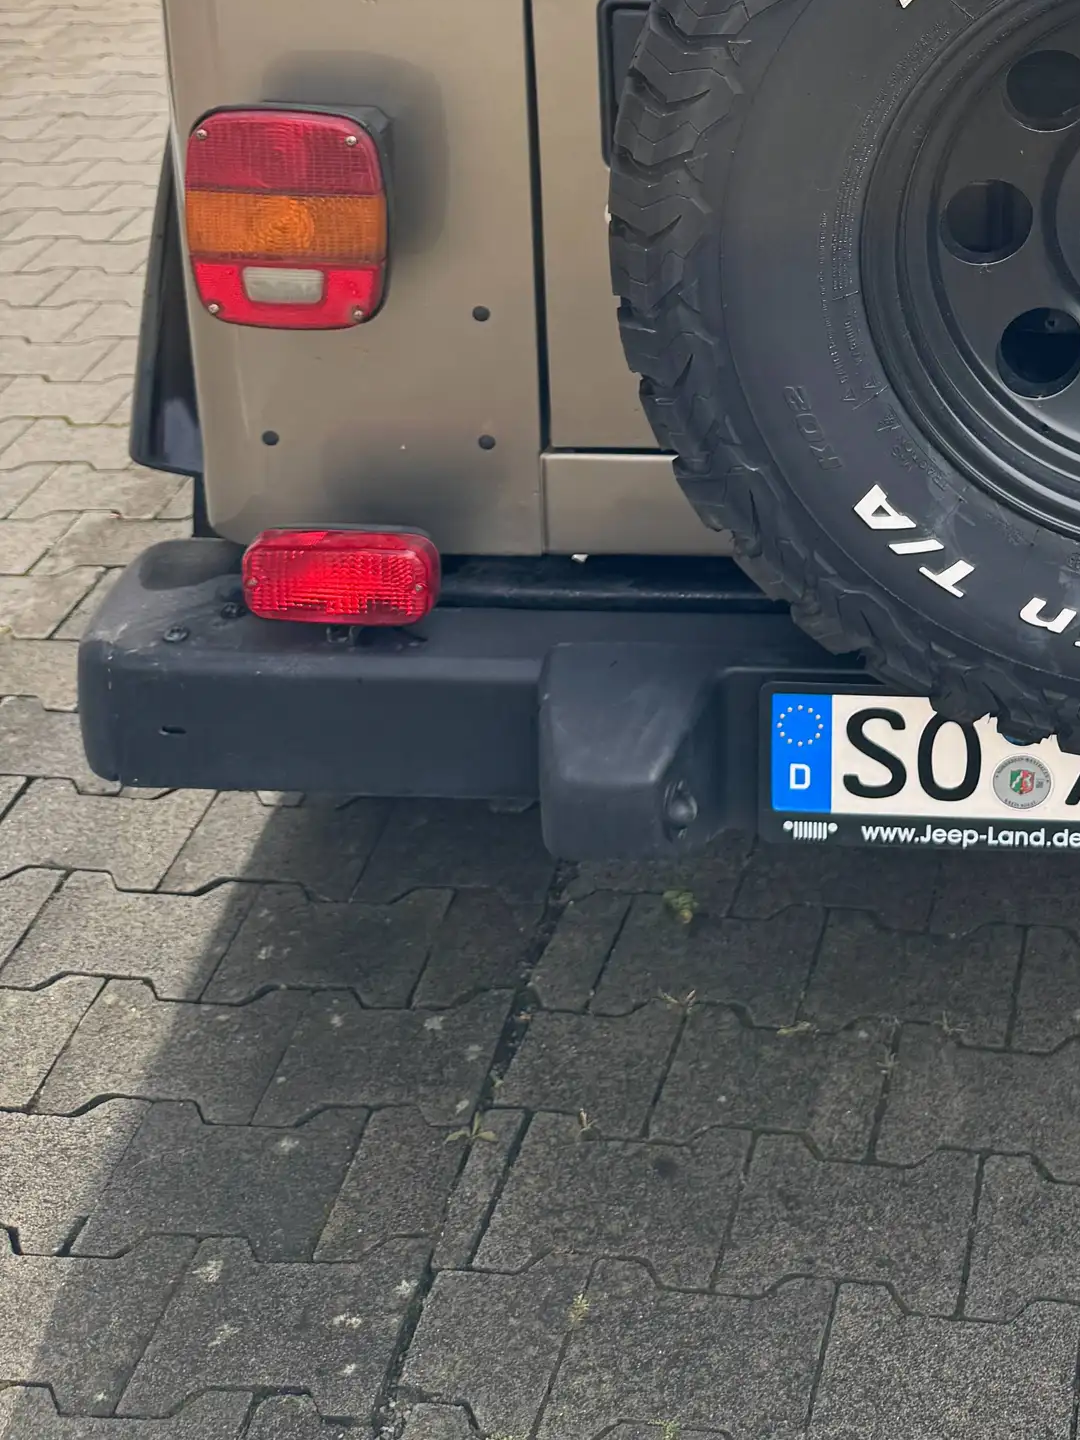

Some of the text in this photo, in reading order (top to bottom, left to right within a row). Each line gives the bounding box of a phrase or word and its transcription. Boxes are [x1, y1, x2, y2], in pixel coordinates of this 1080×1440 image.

[852, 483, 977, 599] T/A
[789, 763, 811, 790] D
[843, 707, 982, 802] SO
